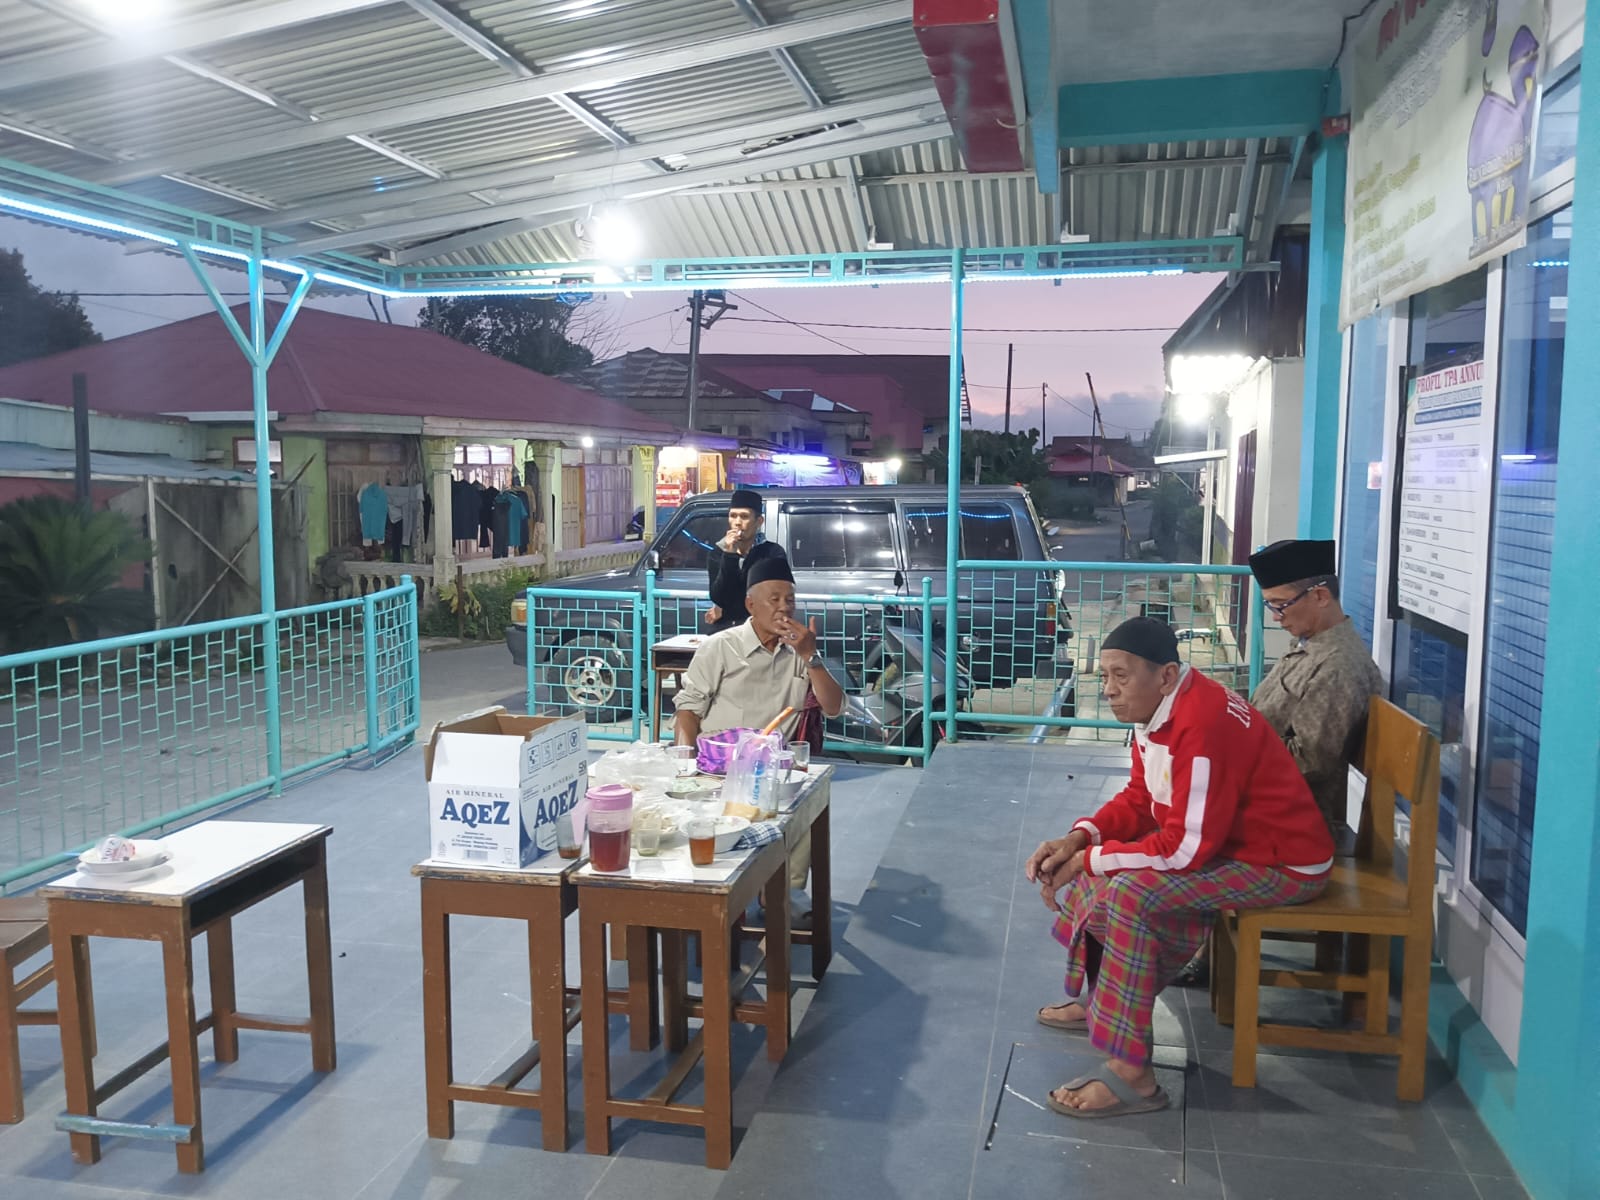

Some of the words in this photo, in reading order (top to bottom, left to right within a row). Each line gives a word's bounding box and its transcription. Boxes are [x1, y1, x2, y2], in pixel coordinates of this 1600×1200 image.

[1416, 373, 1441, 394] PROFIL
[1444, 368, 1458, 388] TPA
[463, 790, 505, 798] MINERAL
[534, 779, 579, 829] AQEZ
[439, 797, 511, 829] AQEZ
